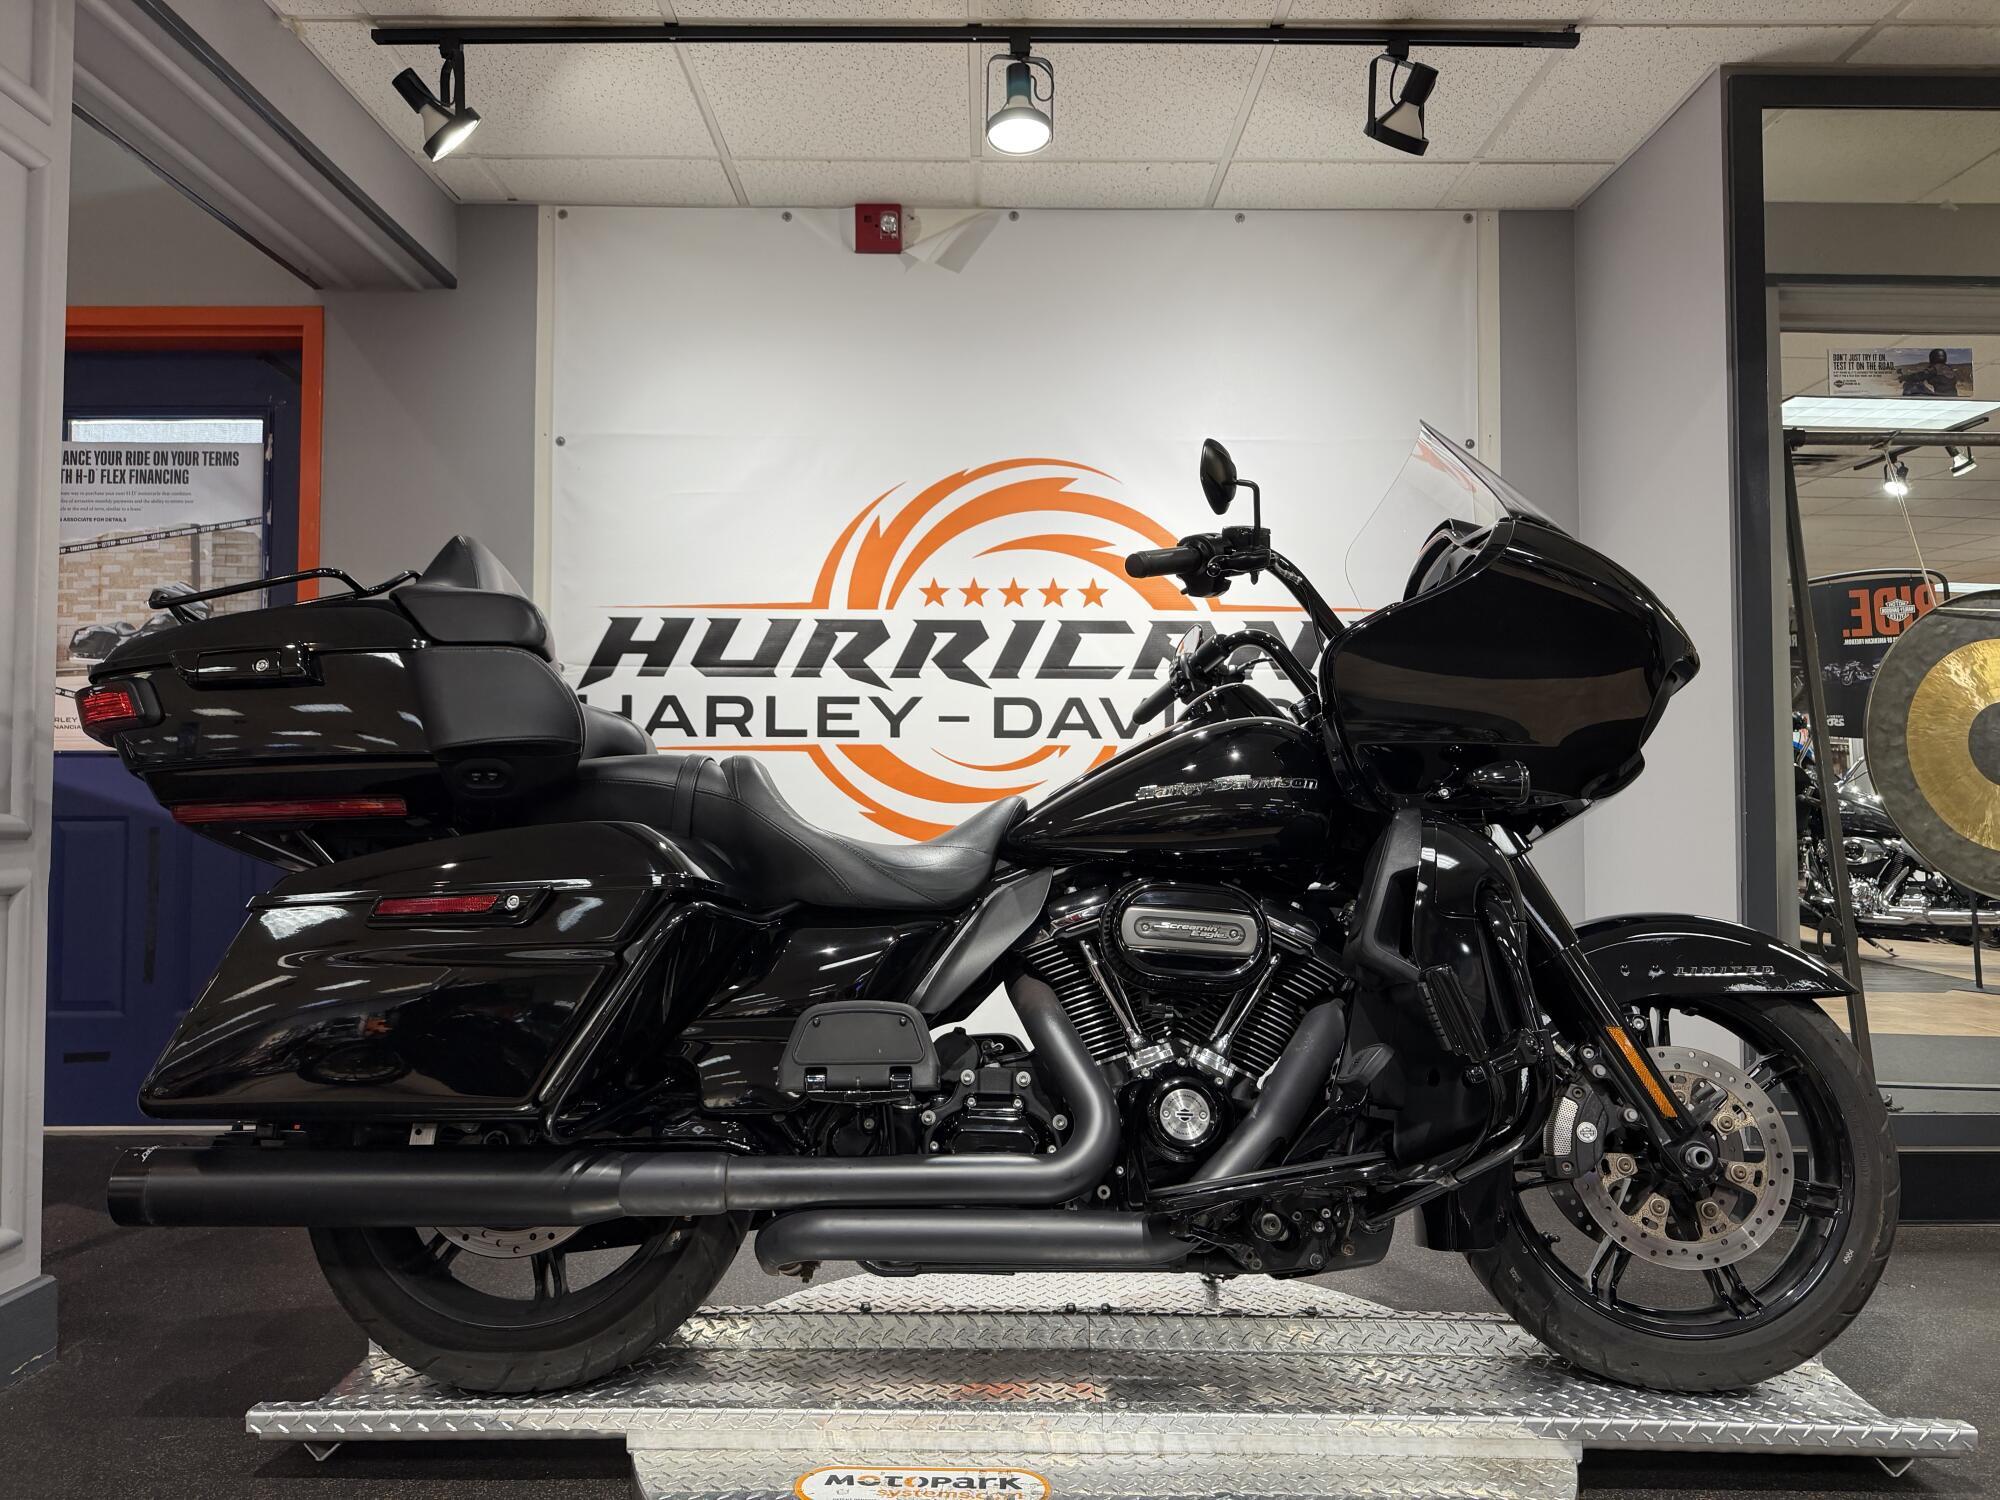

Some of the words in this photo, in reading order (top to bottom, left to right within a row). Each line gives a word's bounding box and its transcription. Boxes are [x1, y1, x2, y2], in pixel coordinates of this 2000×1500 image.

[1833, 361, 1847, 370] TEST
[1848, 361, 1855, 370] IT
[1856, 361, 1865, 370] ON
[1866, 361, 1877, 370] THE
[62, 450, 92, 466] ANCE
[94, 450, 123, 466] YOUR
[125, 450, 151, 466] RIDE
[153, 450, 169, 466] ON
[171, 450, 200, 467] YOUR
[202, 450, 240, 467] TERMS
[100, 469, 127, 485] FLEX
[129, 469, 190, 485] FINANCING
[577, 616, 1345, 692] HURRICAN
[1673, 965, 1776, 977] LIMITED
